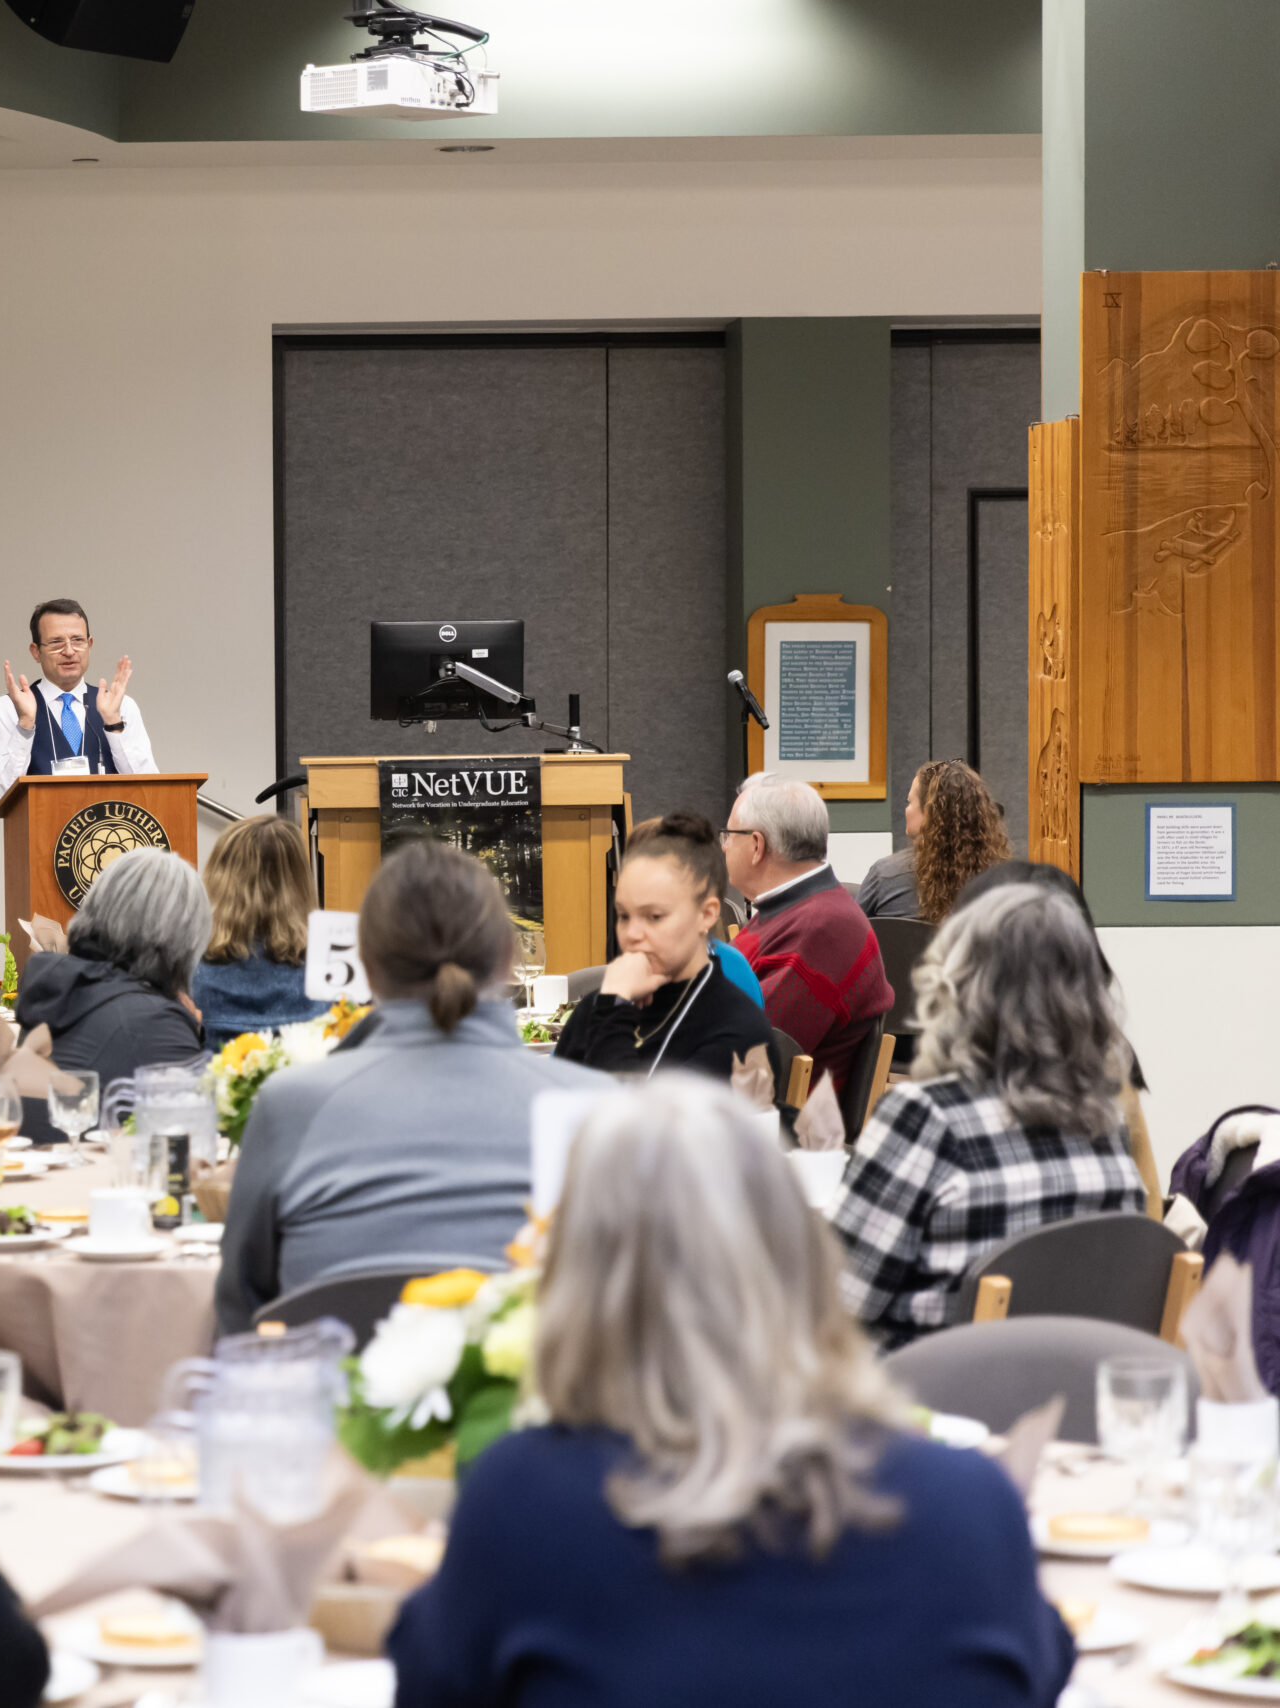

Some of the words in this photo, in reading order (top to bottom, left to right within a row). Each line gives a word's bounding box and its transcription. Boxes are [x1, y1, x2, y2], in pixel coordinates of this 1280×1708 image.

[391, 788, 409, 798] CIC
[411, 770, 528, 797] NetVUE
[458, 801, 500, 809] Undergraduate
[58, 809, 97, 868] PACIFIC
[104, 804, 167, 850] LUTHERA
[325, 943, 356, 987] 5
